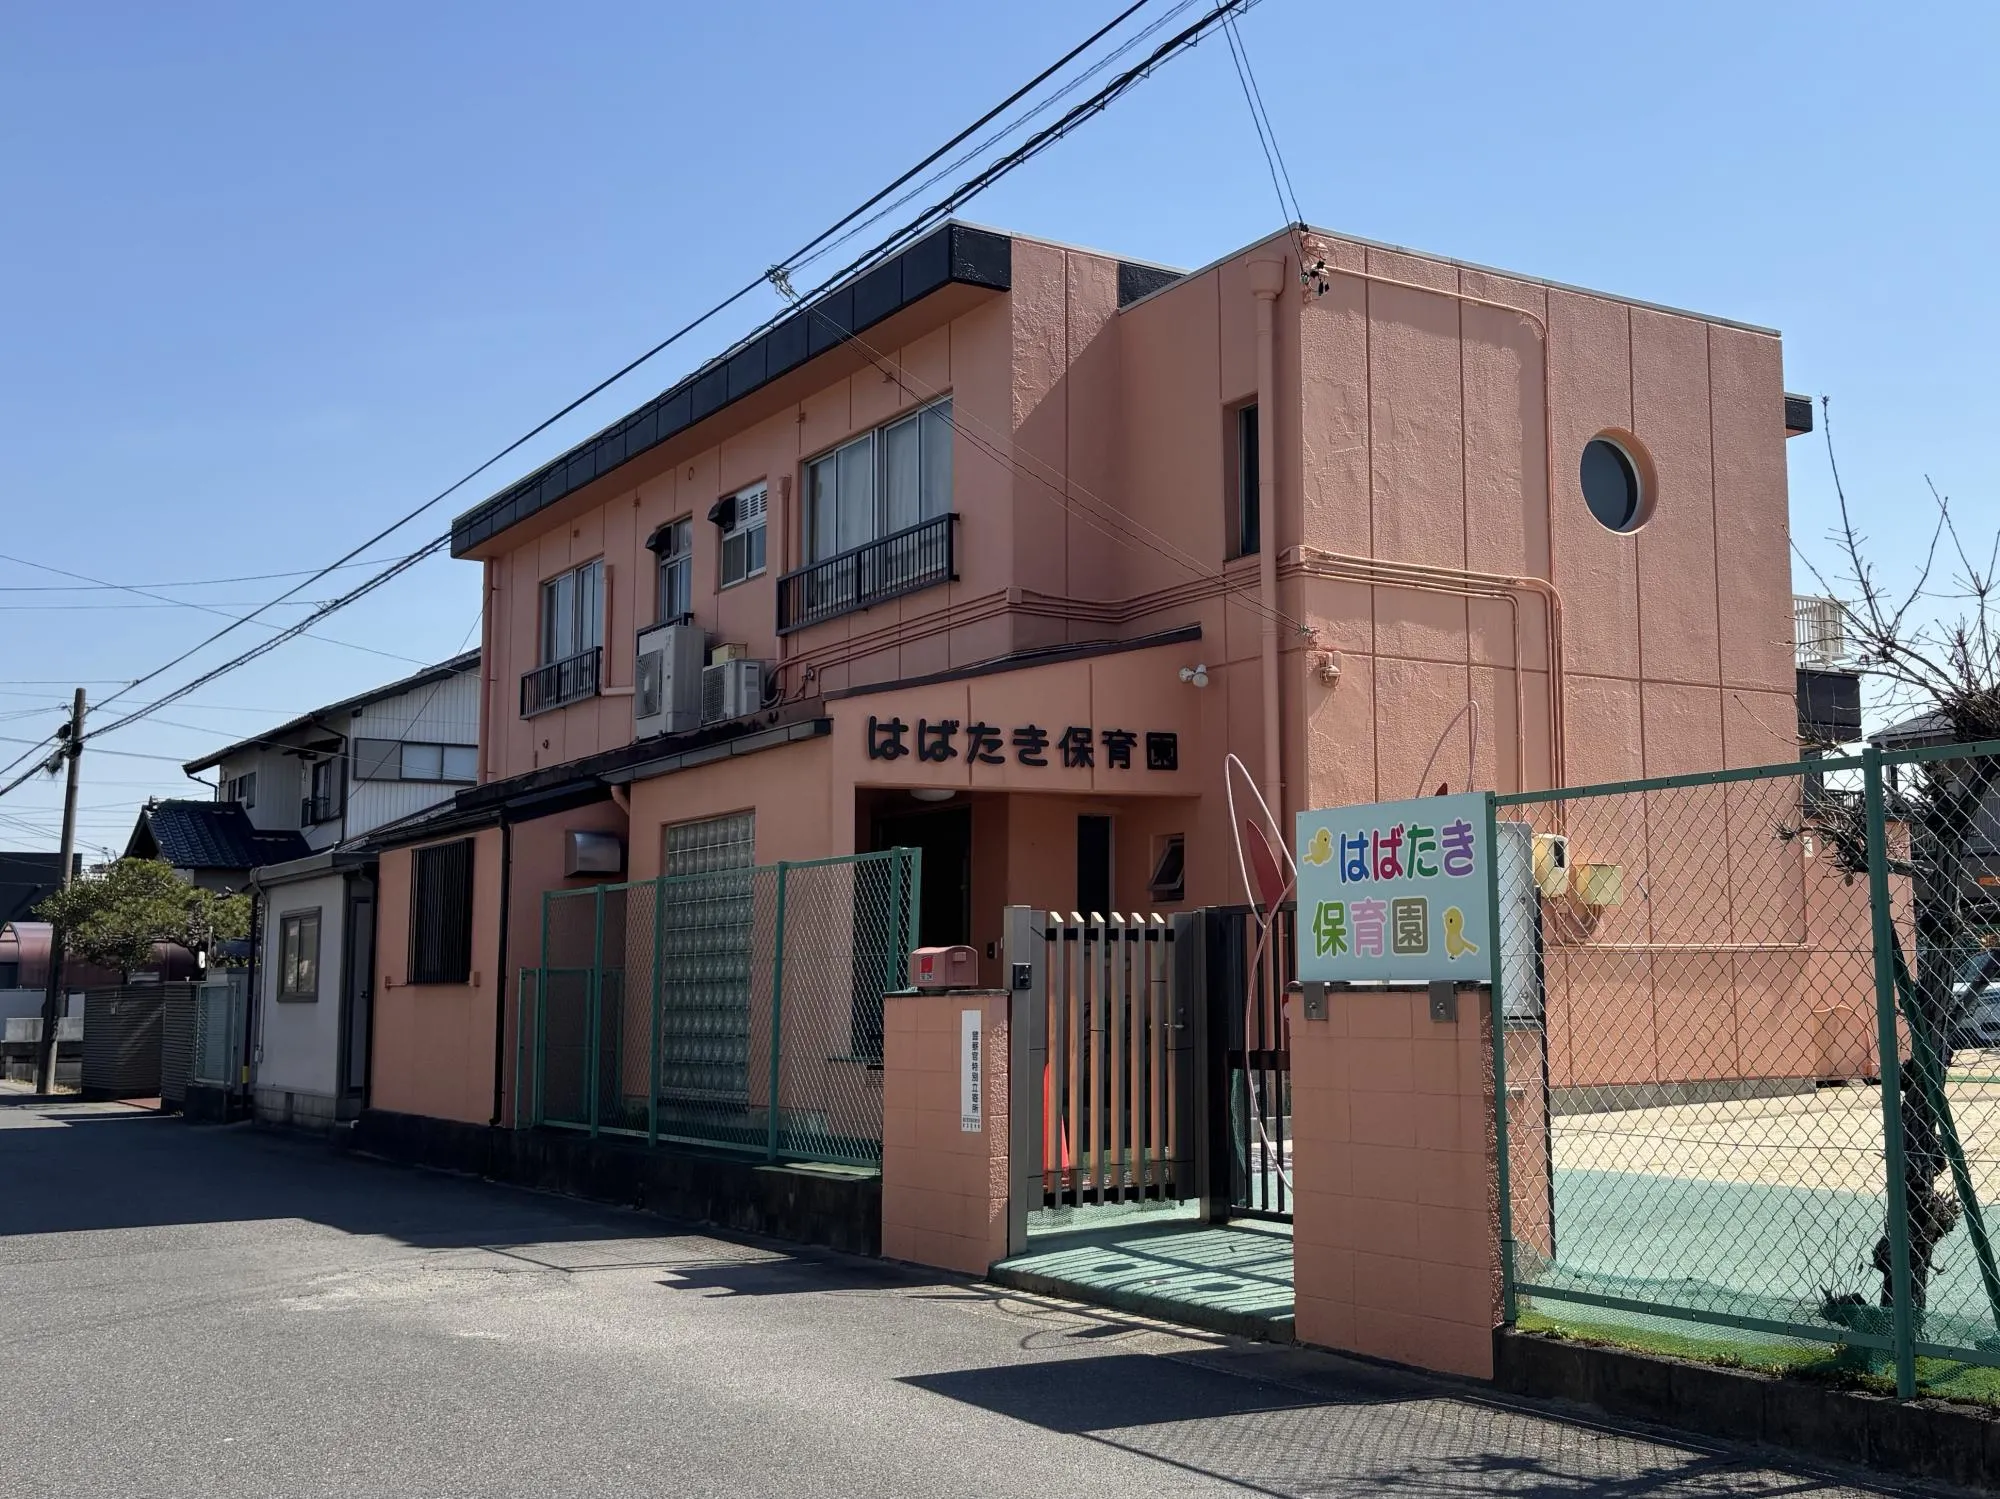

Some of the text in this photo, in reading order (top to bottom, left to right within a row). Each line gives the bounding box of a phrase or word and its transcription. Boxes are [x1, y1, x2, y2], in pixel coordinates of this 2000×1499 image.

[868, 715, 1178, 771] はばたき保育園
[1339, 817, 1475, 884] はばたき
[1312, 896, 1430, 958] 保育園
